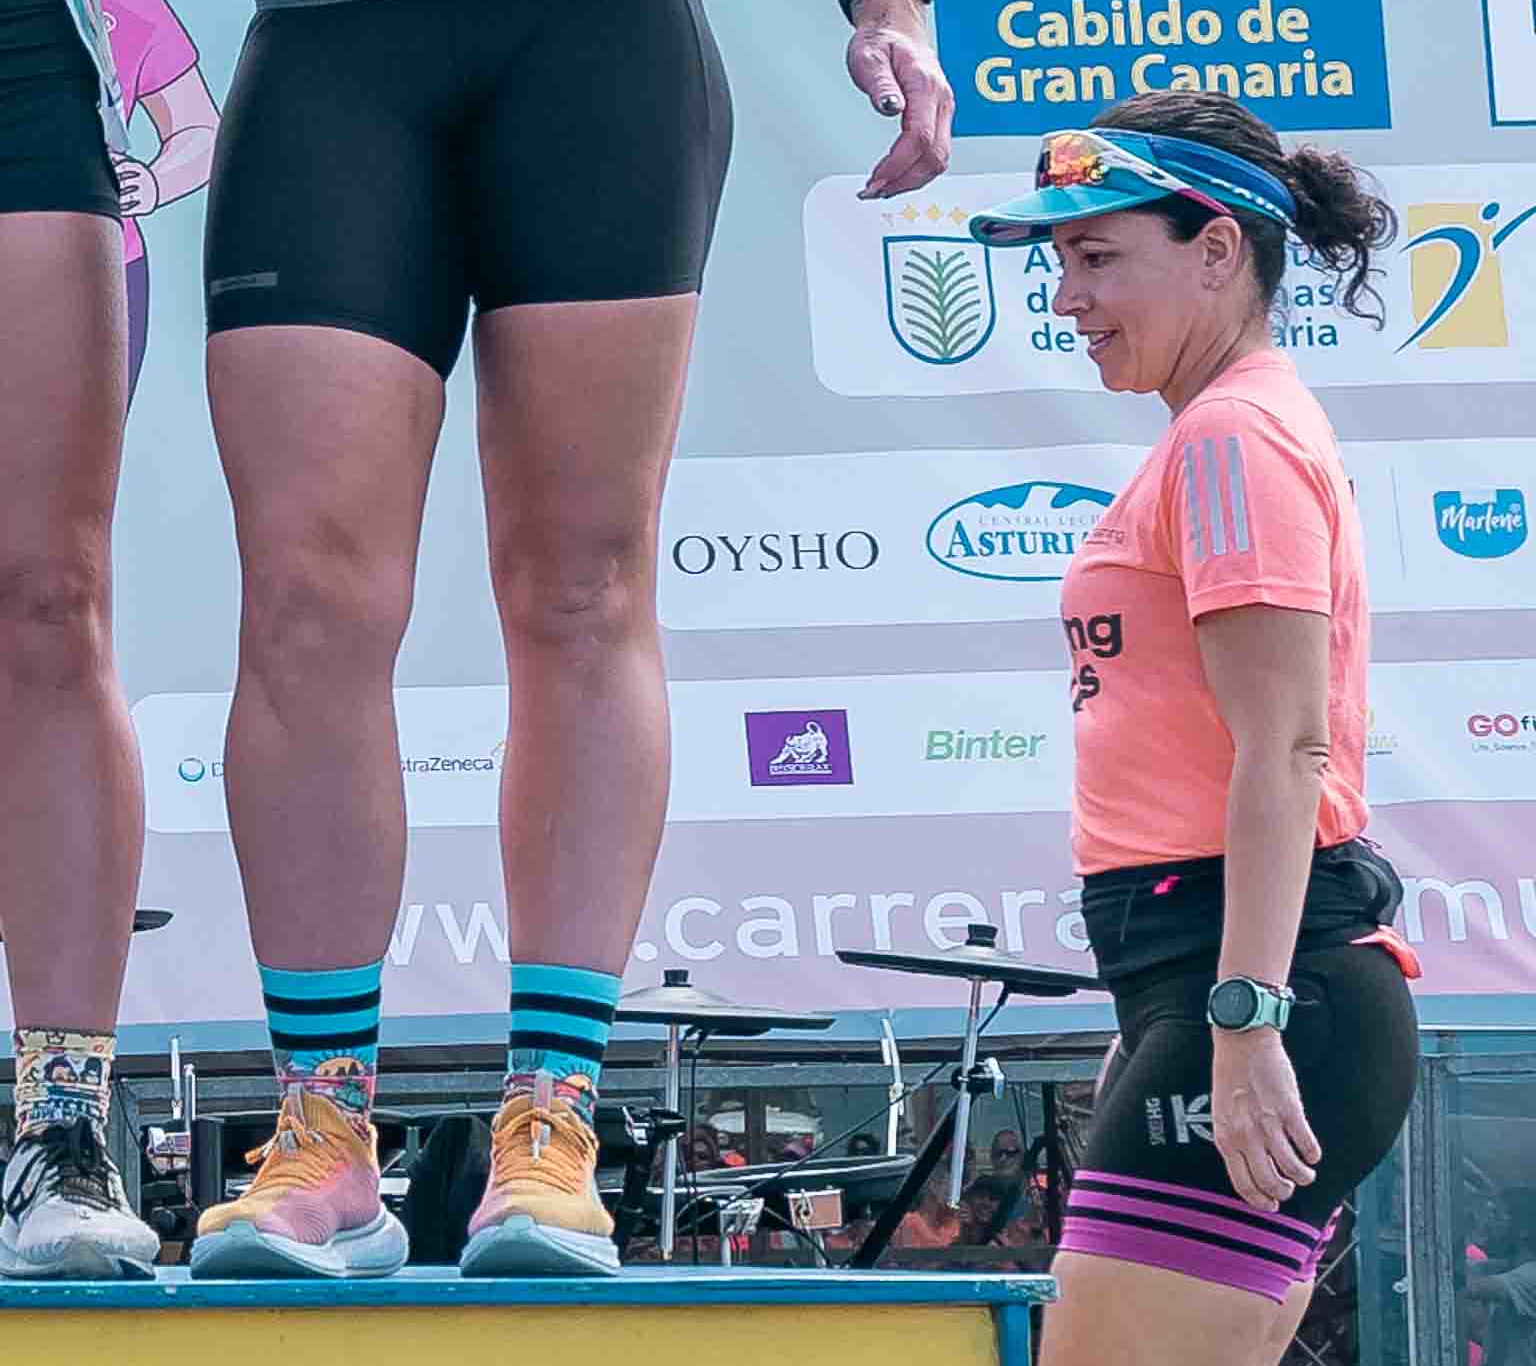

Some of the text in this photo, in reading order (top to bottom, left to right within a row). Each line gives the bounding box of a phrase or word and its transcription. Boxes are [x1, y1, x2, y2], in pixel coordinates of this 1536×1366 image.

[974, 48, 1355, 104] Gran Canaria
[1031, 321, 1075, 353] de
[1440, 503, 1524, 542] Marlene
[671, 520, 1088, 575] OYSHO ASTURI
[924, 727, 1047, 761] Binter
[400, 756, 494, 774] traZeneca
